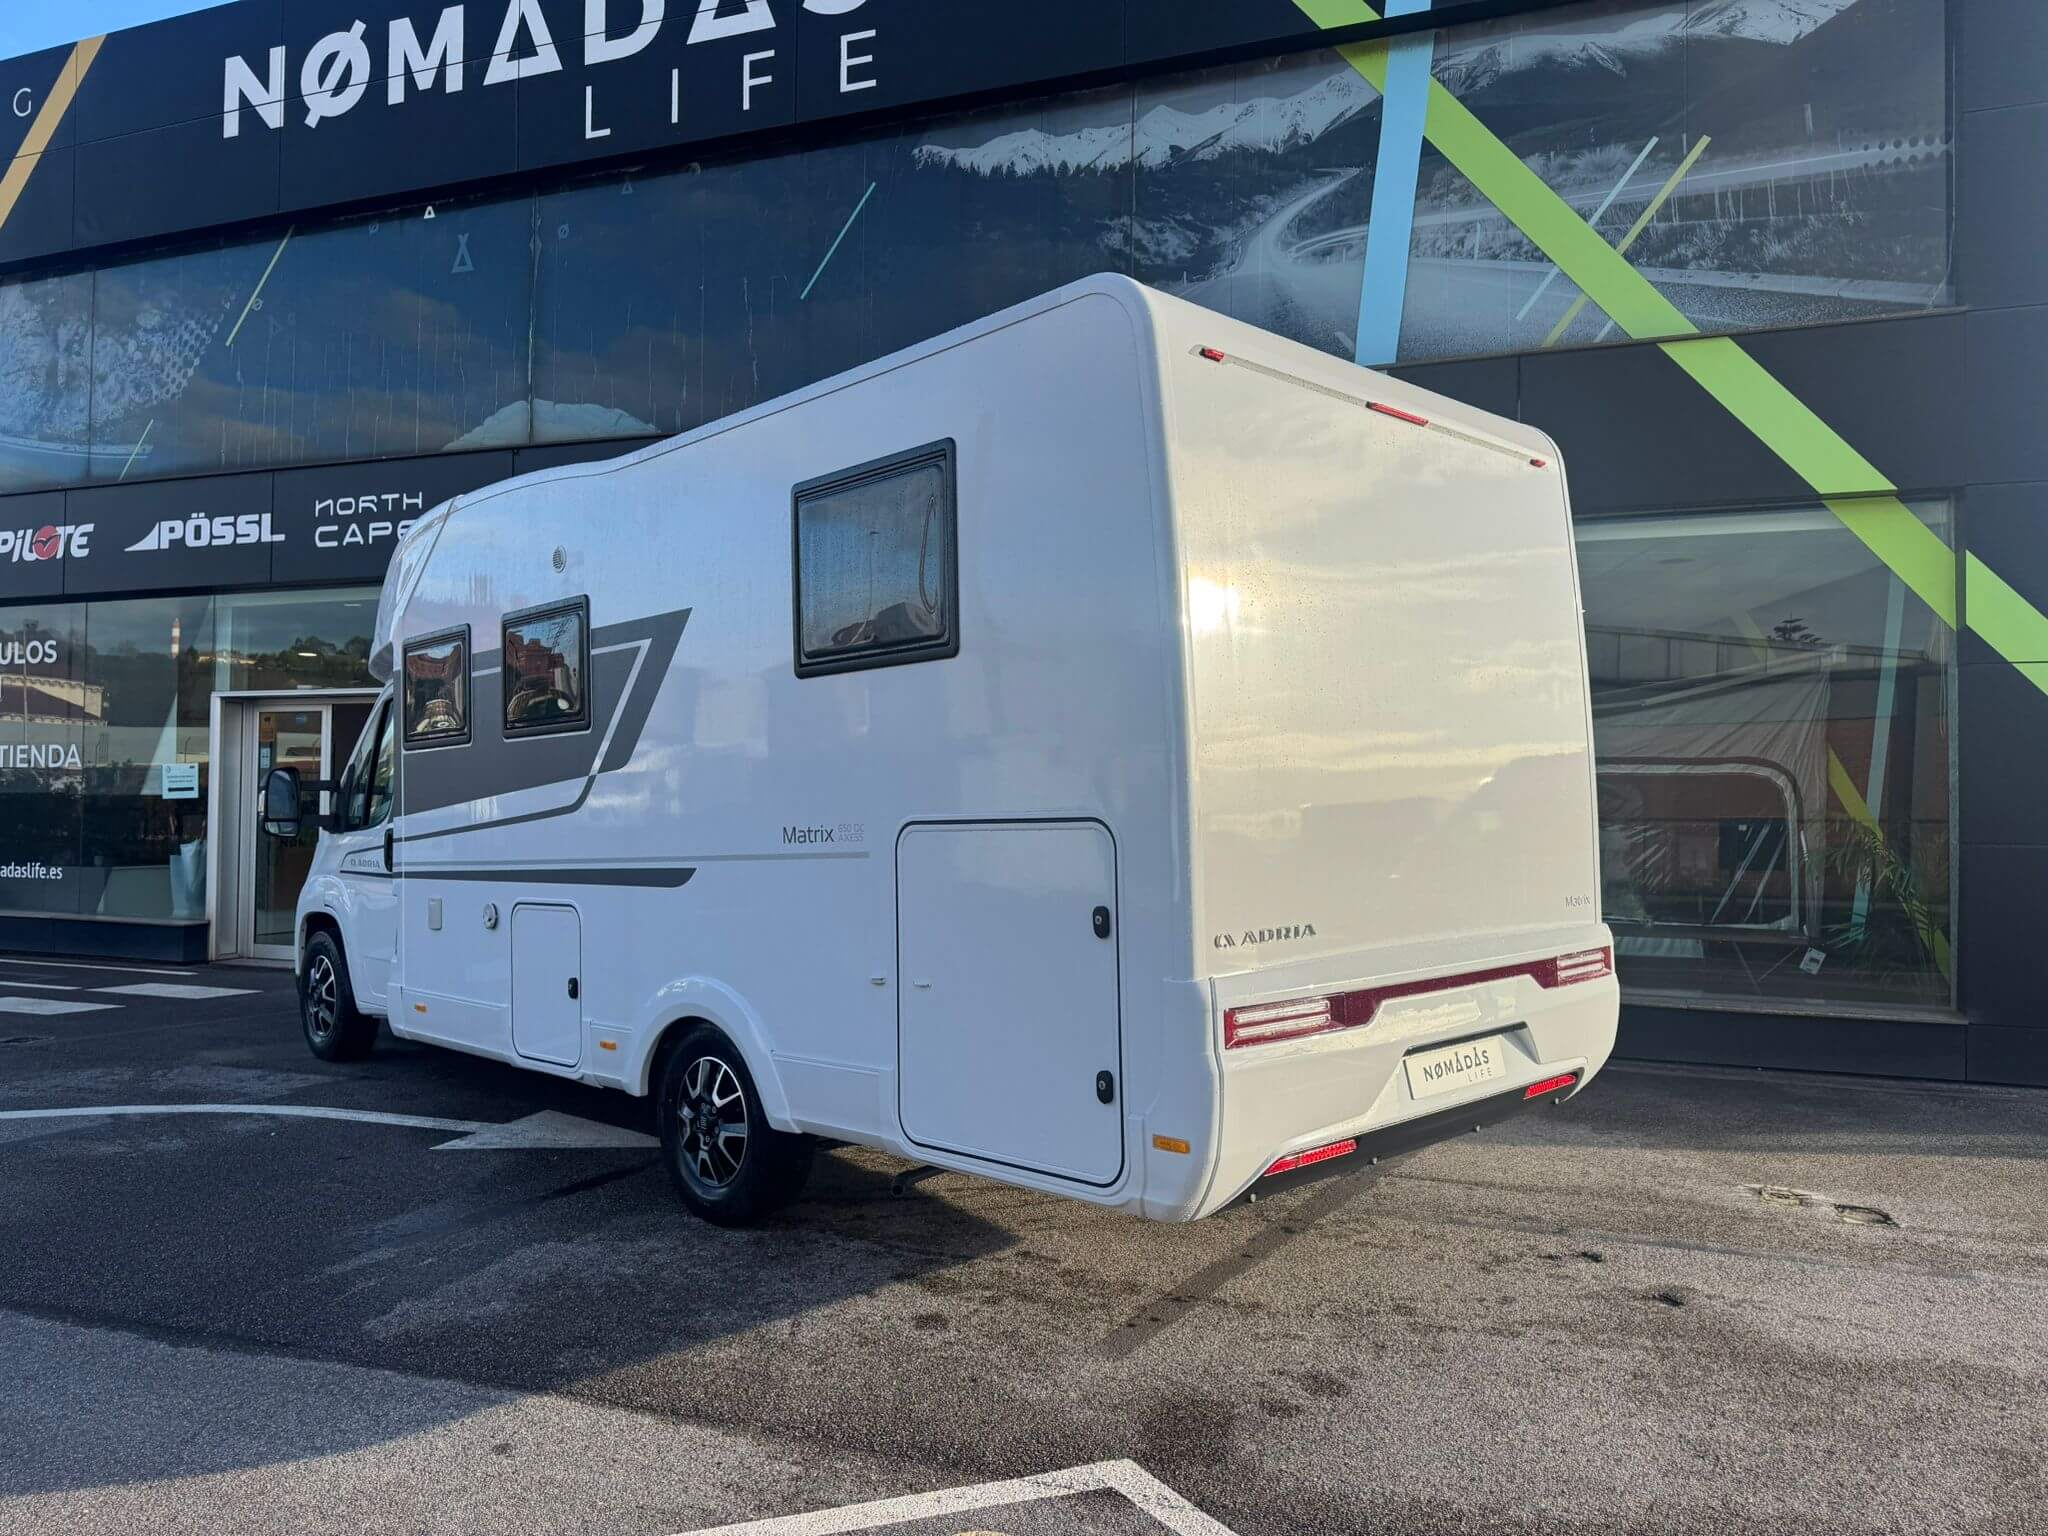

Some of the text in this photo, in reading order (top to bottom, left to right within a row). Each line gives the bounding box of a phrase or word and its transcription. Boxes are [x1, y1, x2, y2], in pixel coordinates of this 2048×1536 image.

[585, 28, 877, 139] LIFE
[315, 491, 423, 518] NORTH
[159, 512, 286, 550] PÖSSL
[782, 825, 835, 844] Matrix
[0, 861, 63, 880] adaslife.es
[1565, 893, 1591, 909] Matrix
[1240, 923, 1317, 946] ADRIA
[1466, 1067, 1493, 1083] LIFE
